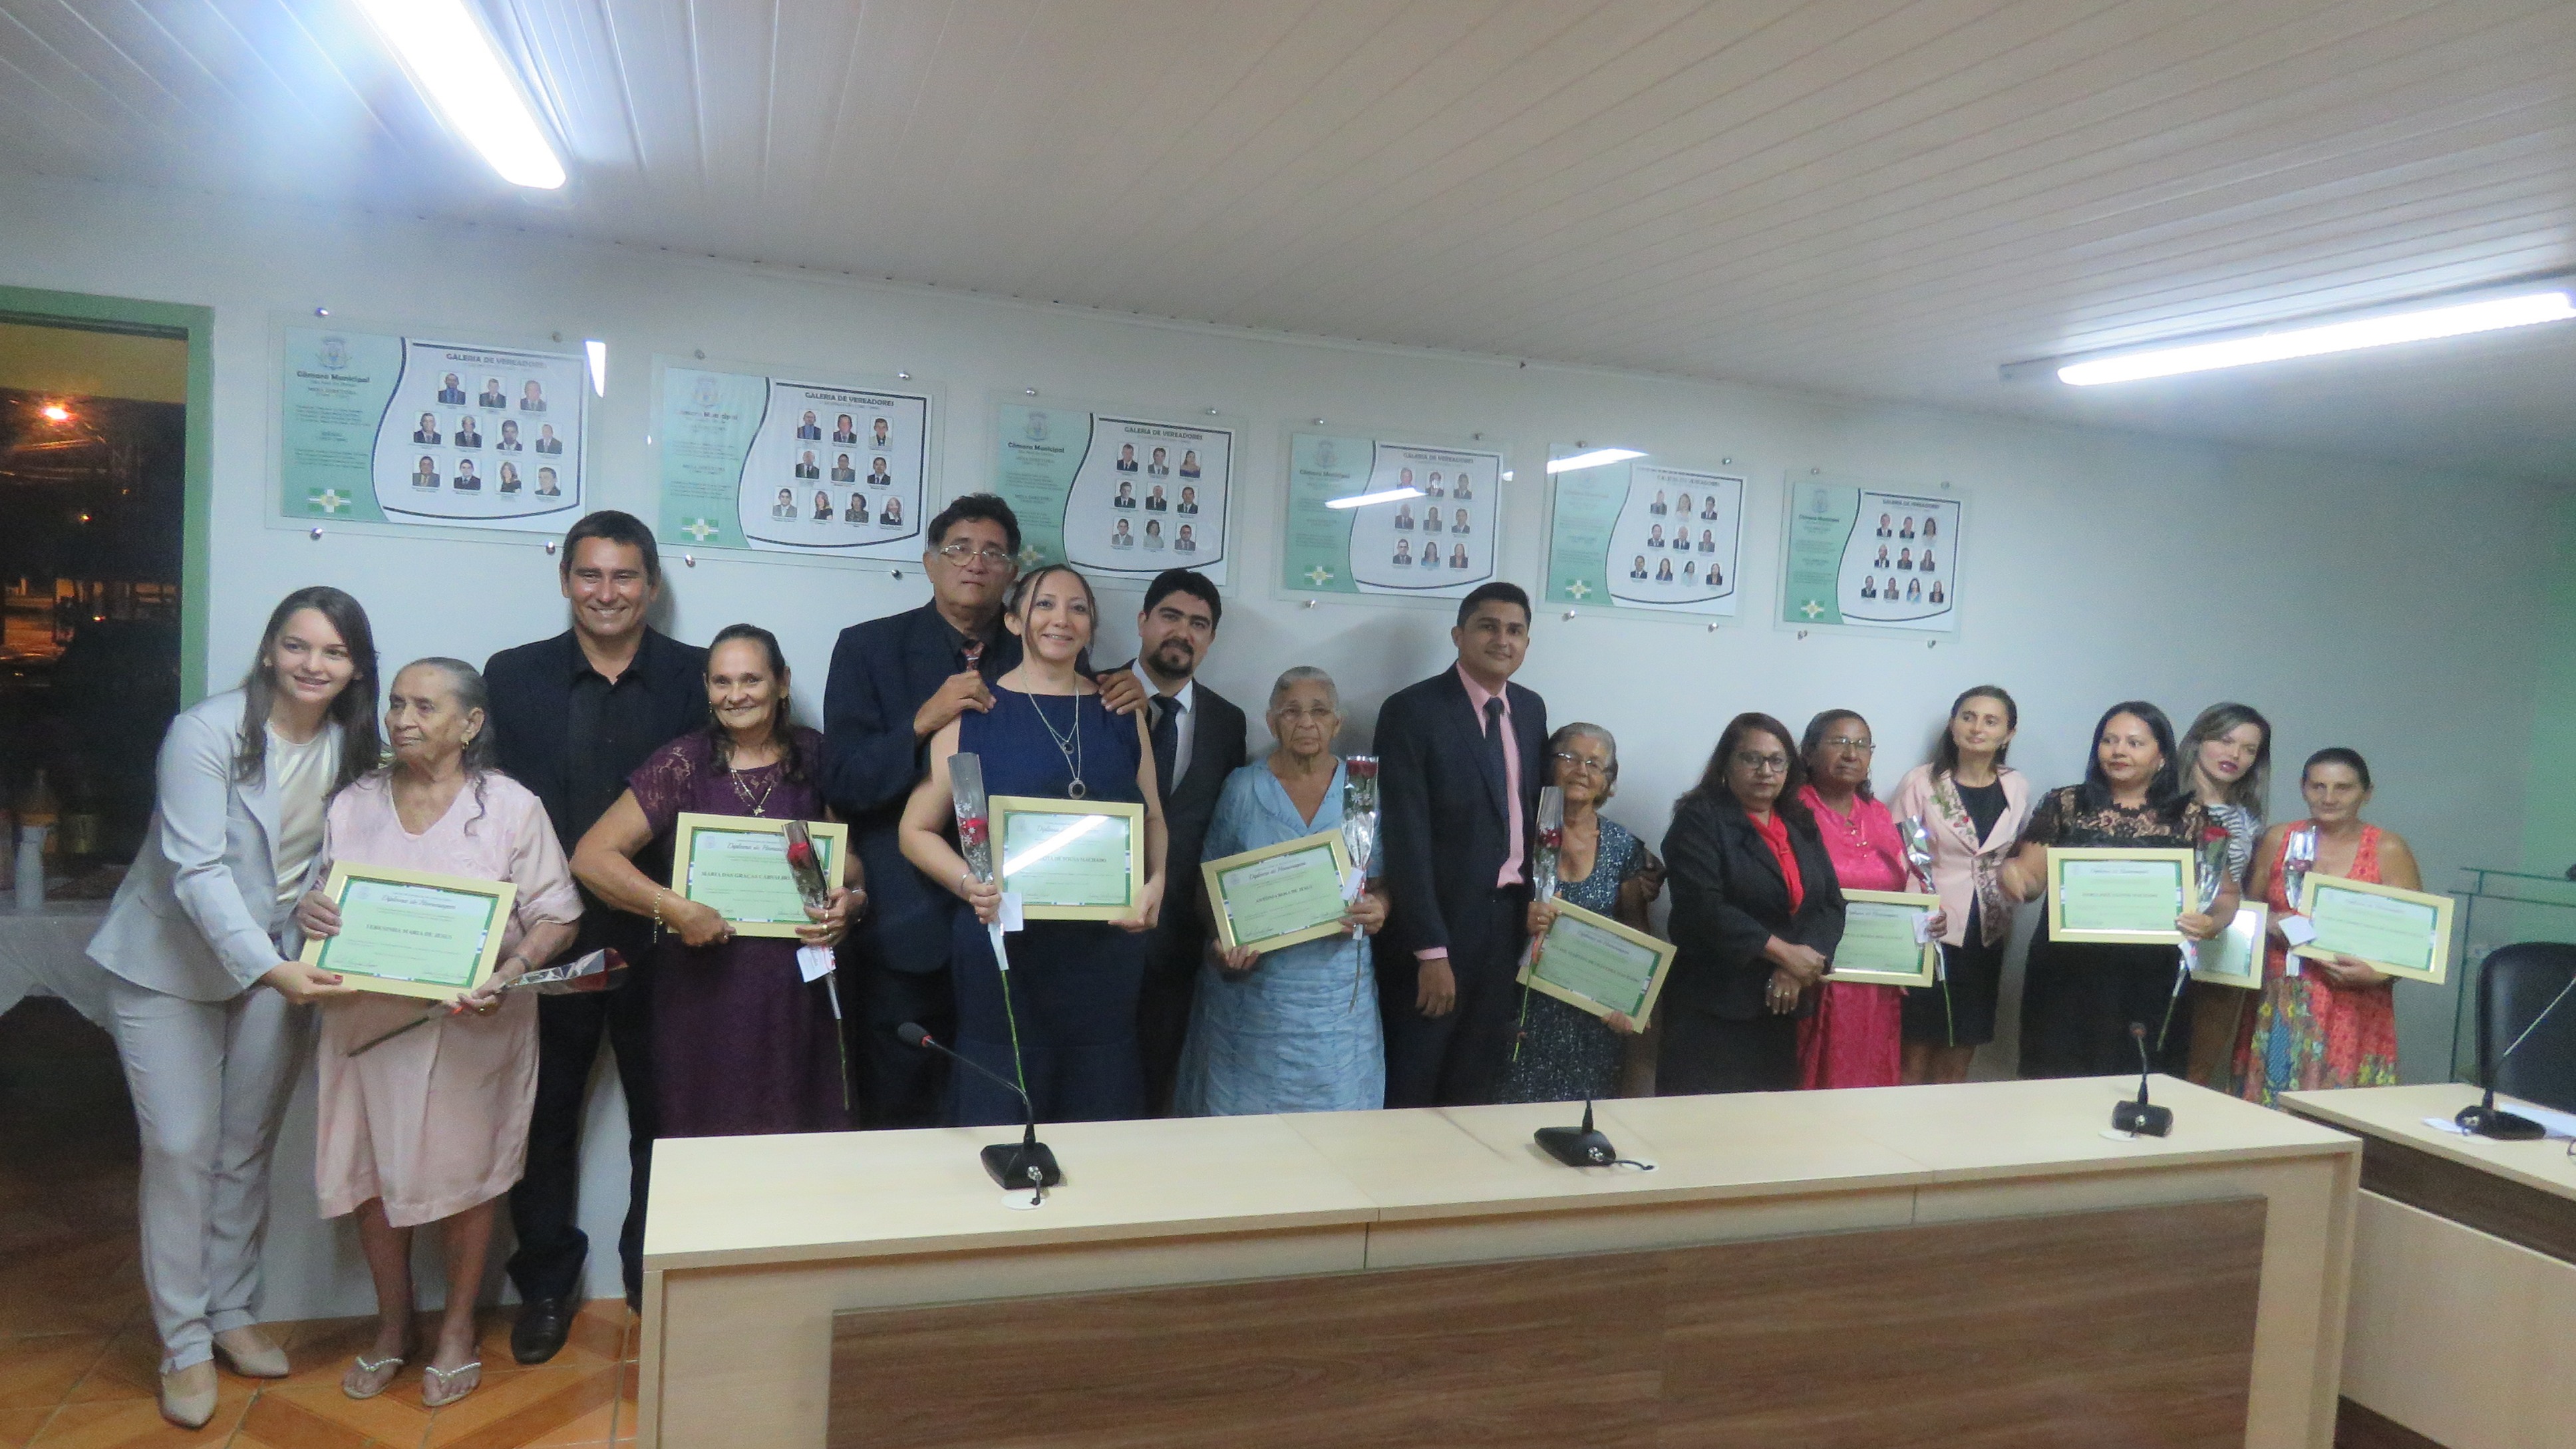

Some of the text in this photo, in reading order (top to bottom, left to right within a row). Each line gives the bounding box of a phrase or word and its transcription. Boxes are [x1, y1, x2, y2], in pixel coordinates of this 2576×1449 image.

[849, 397, 894, 406] VEREADORES
[1124, 426, 1151, 435] GALERIA
[1162, 430, 1203, 440] VEREADORES
[1034, 444, 1064, 453] Municipal
